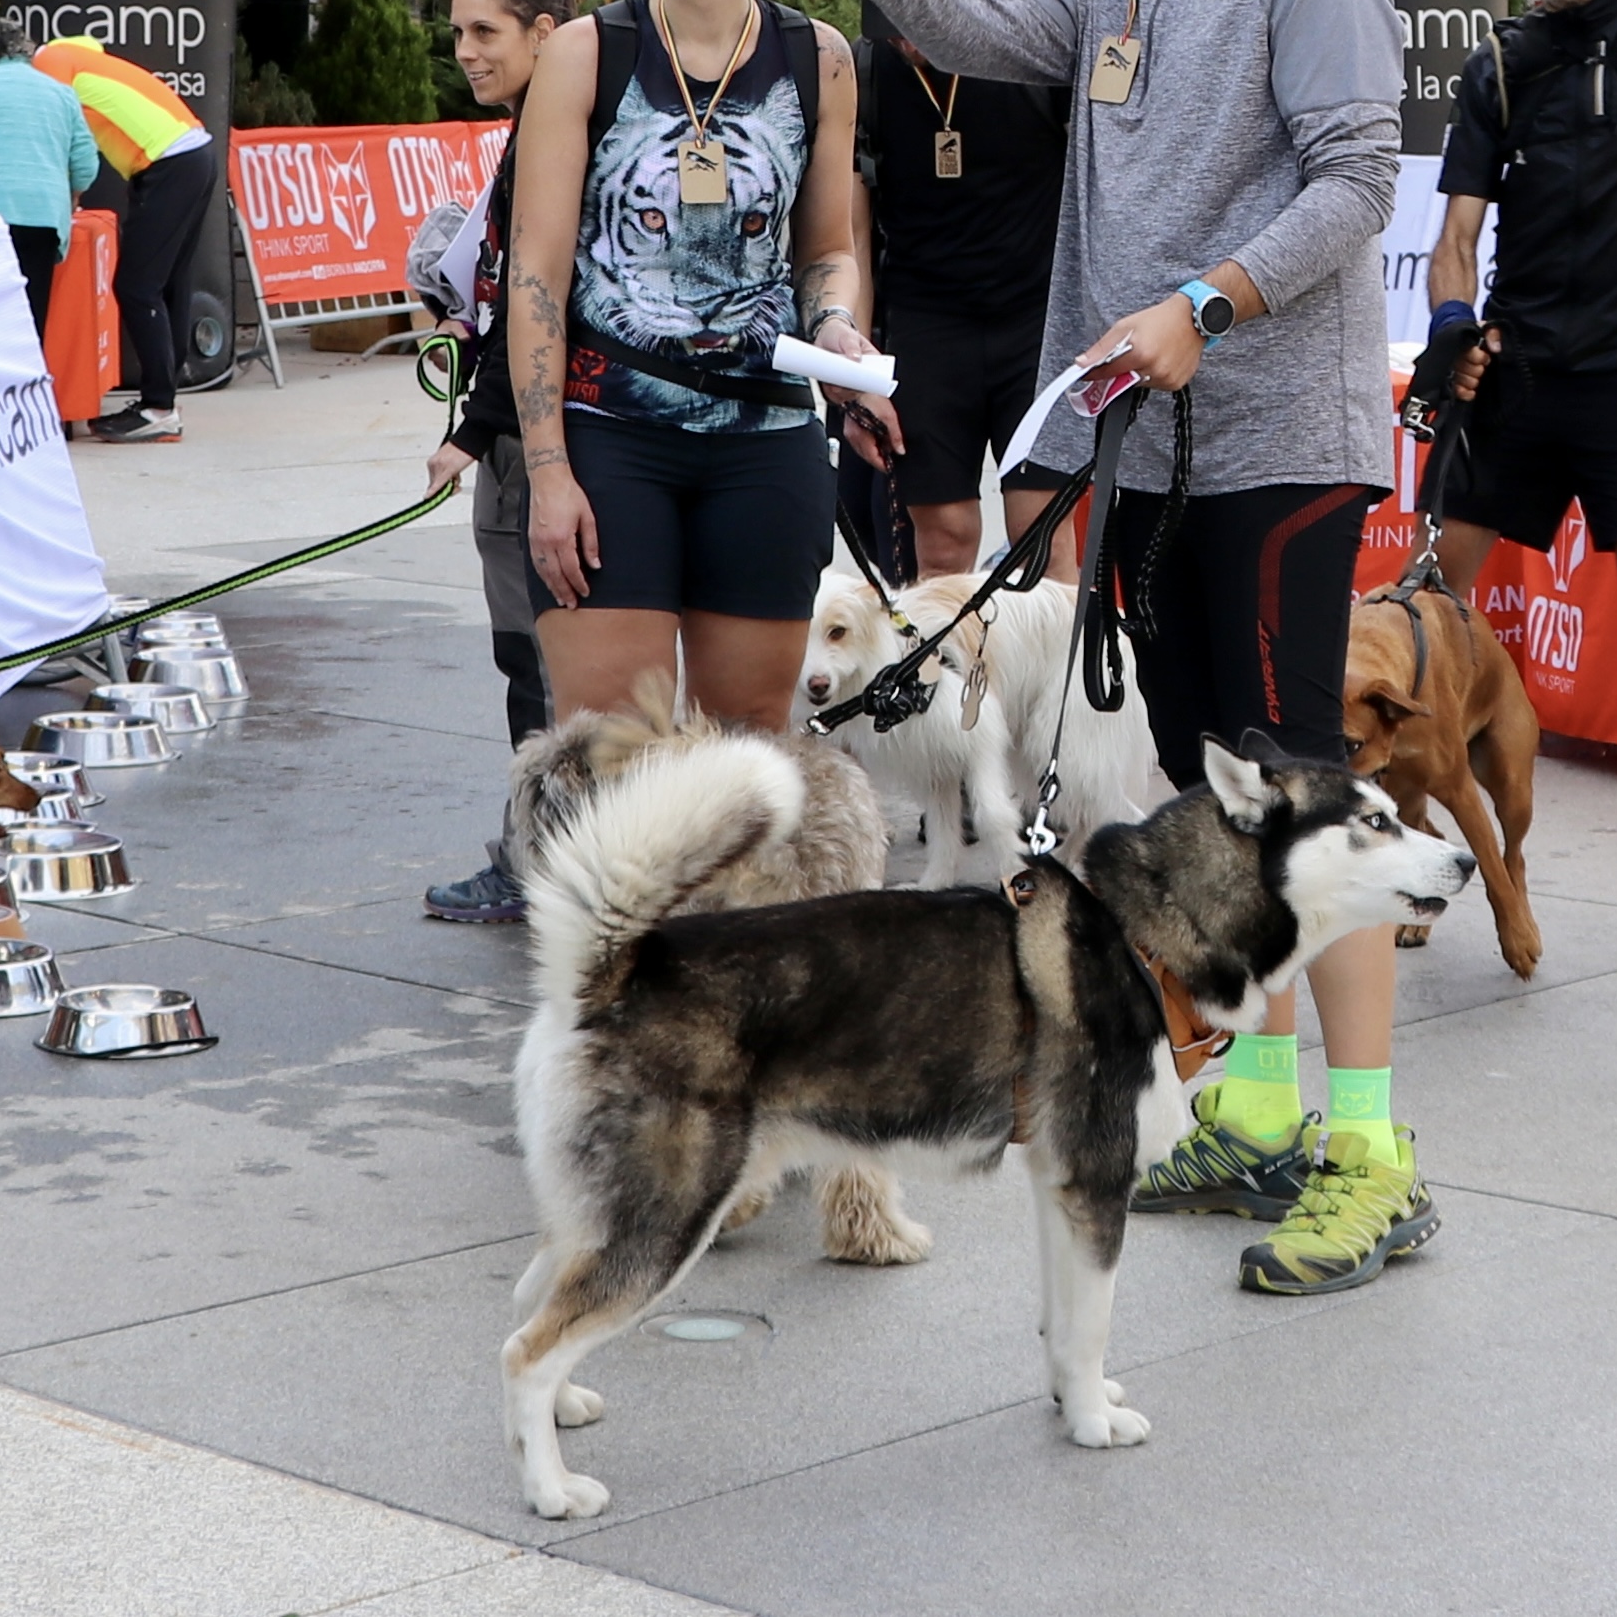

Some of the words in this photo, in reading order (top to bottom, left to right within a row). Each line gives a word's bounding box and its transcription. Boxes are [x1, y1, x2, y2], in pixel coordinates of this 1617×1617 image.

[239, 142, 326, 231] OTSO
[256, 238, 291, 260] THINK
[292, 233, 330, 255] SPORT
[1527, 595, 1583, 672] OTSO
